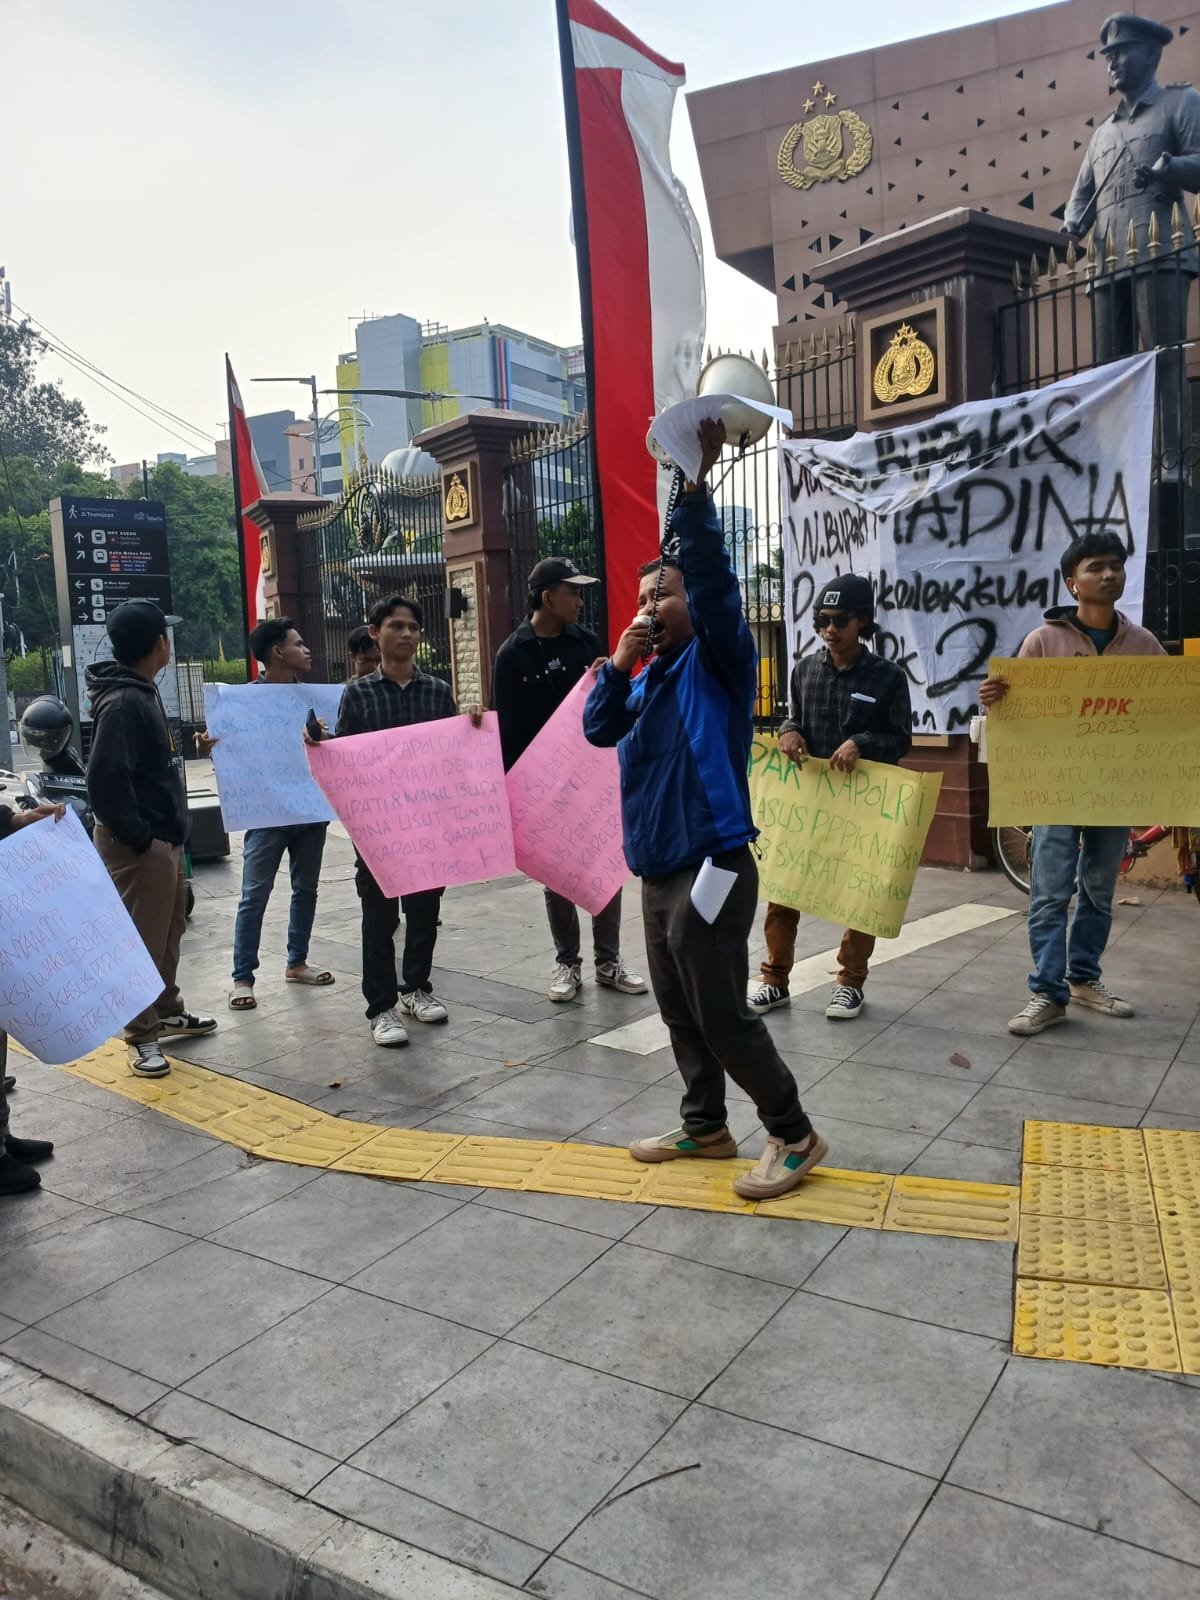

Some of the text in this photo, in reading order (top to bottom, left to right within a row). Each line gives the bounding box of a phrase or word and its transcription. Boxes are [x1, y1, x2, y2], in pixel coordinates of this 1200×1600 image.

[1080, 698, 1133, 717] PPPK
[1076, 720, 1139, 737] 2023
[384, 736, 463, 761] KAPOLDA
[389, 766, 439, 785] MATA
[755, 797, 808, 833] ASUS
[811, 809, 866, 854] PPPK
[776, 841, 847, 884] SYARAT
